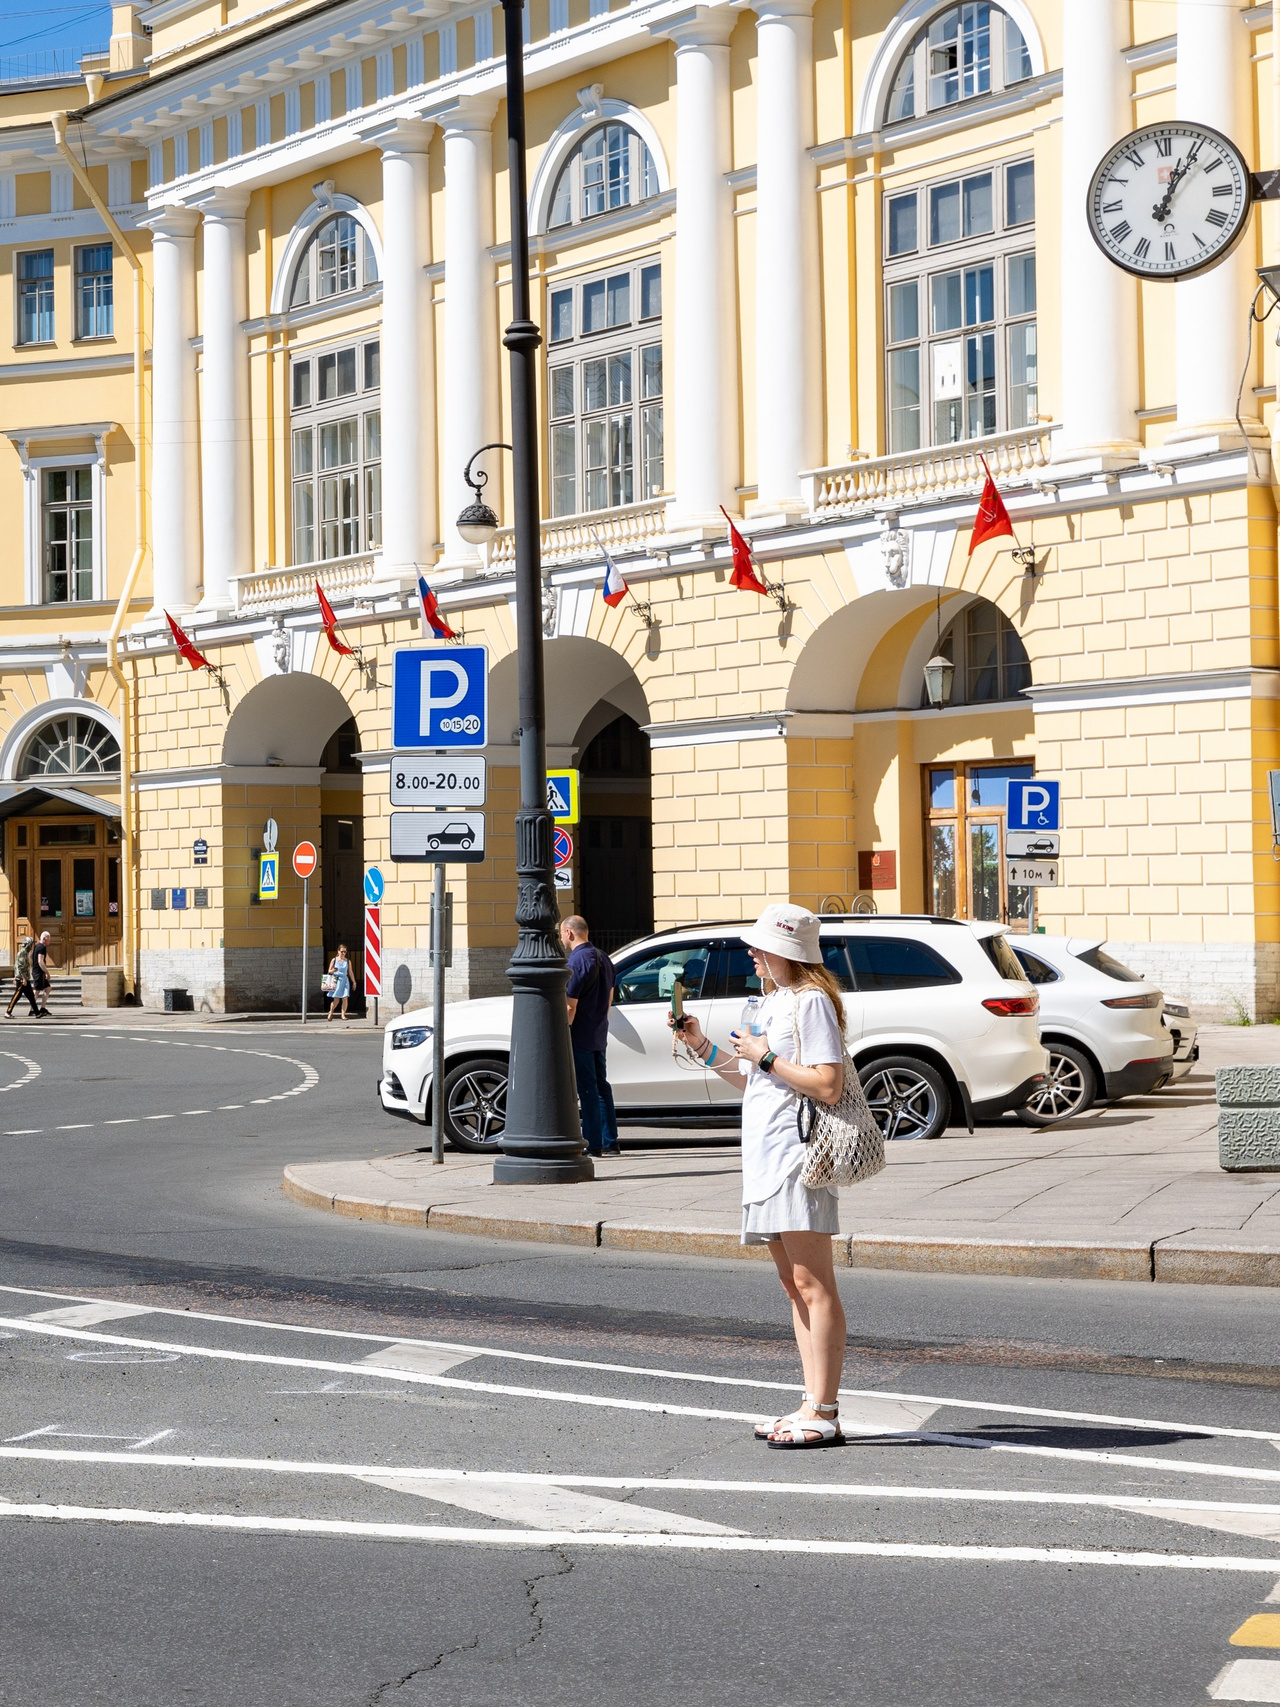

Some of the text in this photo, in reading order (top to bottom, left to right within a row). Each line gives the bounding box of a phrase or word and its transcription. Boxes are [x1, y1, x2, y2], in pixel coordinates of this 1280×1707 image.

[1154, 137, 1172, 158] XII
[1124, 149, 1145, 171] XI
[1203, 157, 1223, 174] II
[1108, 174, 1129, 187] X
[1212, 184, 1233, 197] III
[419, 659, 469, 737] P
[442, 719, 479, 730] 10 15 20
[395, 772, 480, 790] 8.00-20.00
[1021, 786, 1050, 825] P
